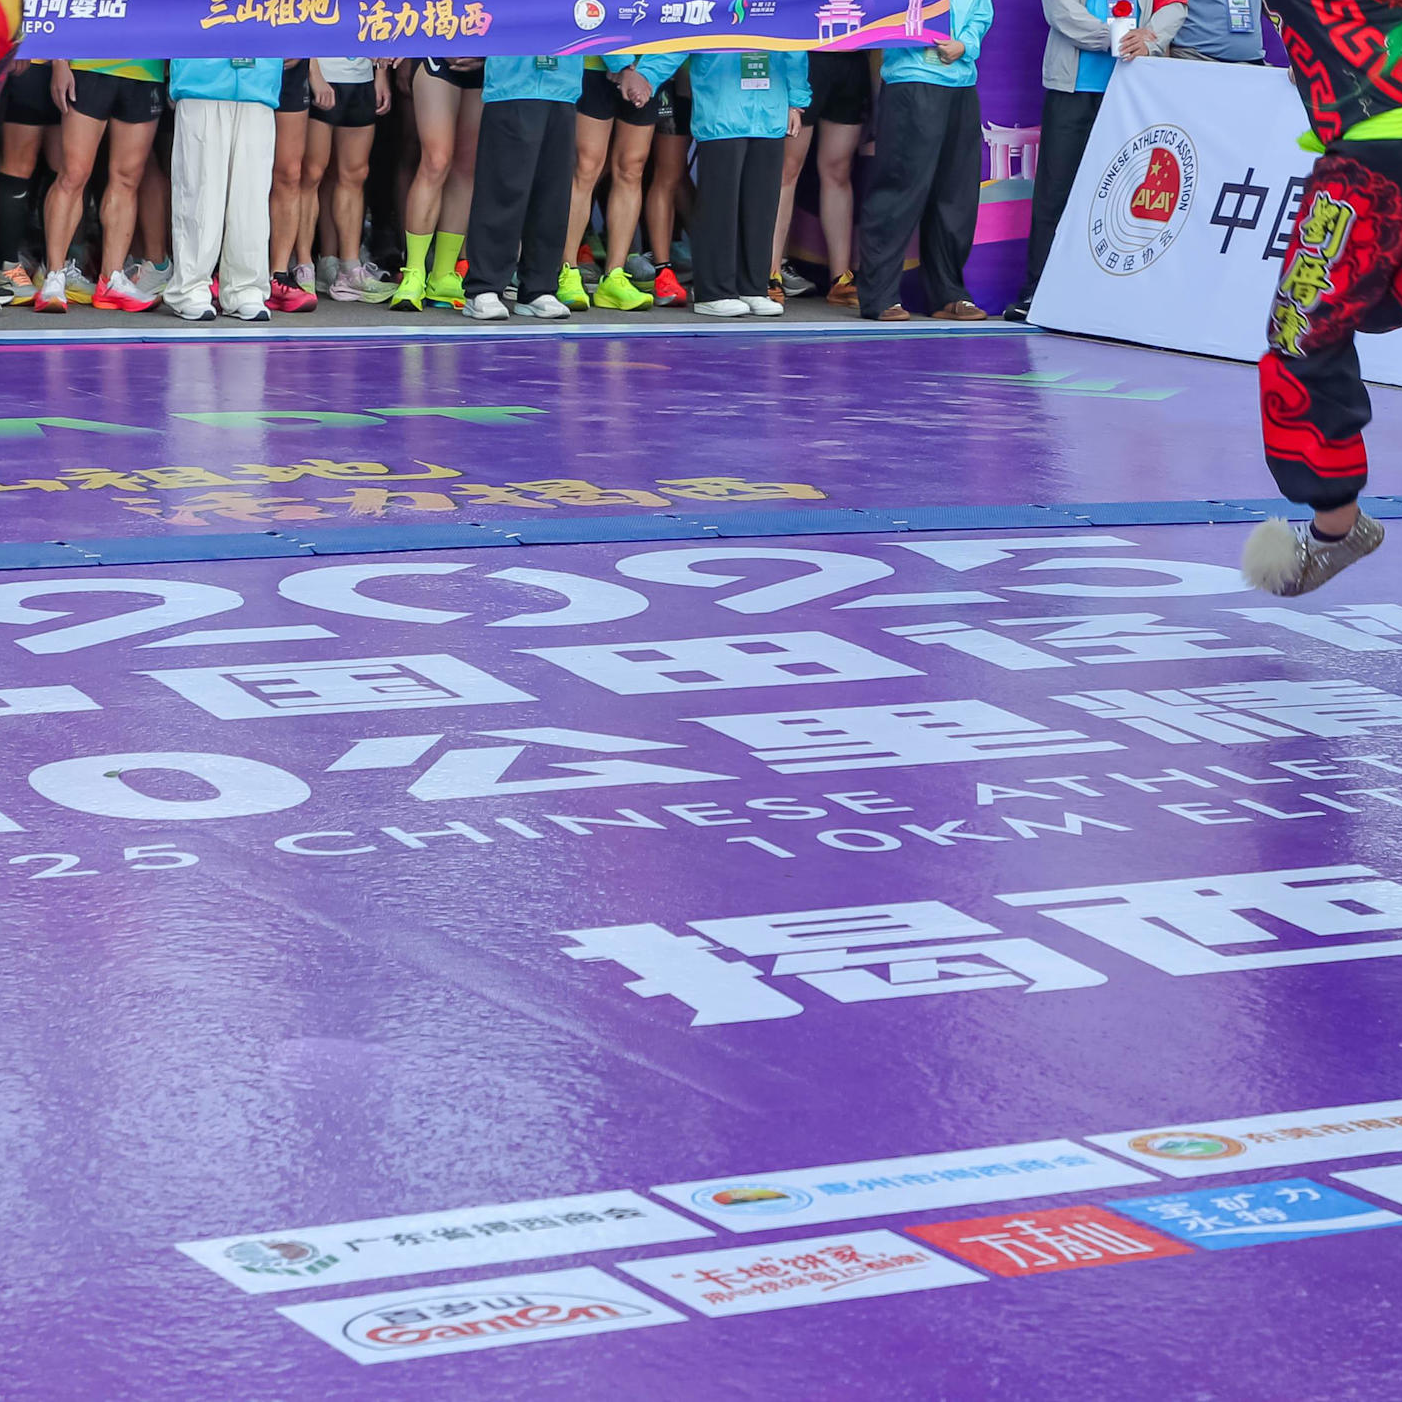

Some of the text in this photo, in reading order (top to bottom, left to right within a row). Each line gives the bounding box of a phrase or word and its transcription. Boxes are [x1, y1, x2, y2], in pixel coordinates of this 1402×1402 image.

[357, 0, 493, 42] 活力揭西
[661, 3, 684, 16] 中国
[683, 0, 716, 25] 10K
[1098, 130, 1194, 211] CHINESE ATHLETICS ASSOCIATION
[275, 790, 914, 856] CHINESE
[727, 809, 1131, 858] 10KM
[344, 1206, 648, 1253] 广东省揭西商会
[375, 1295, 536, 1326] 百岁山
